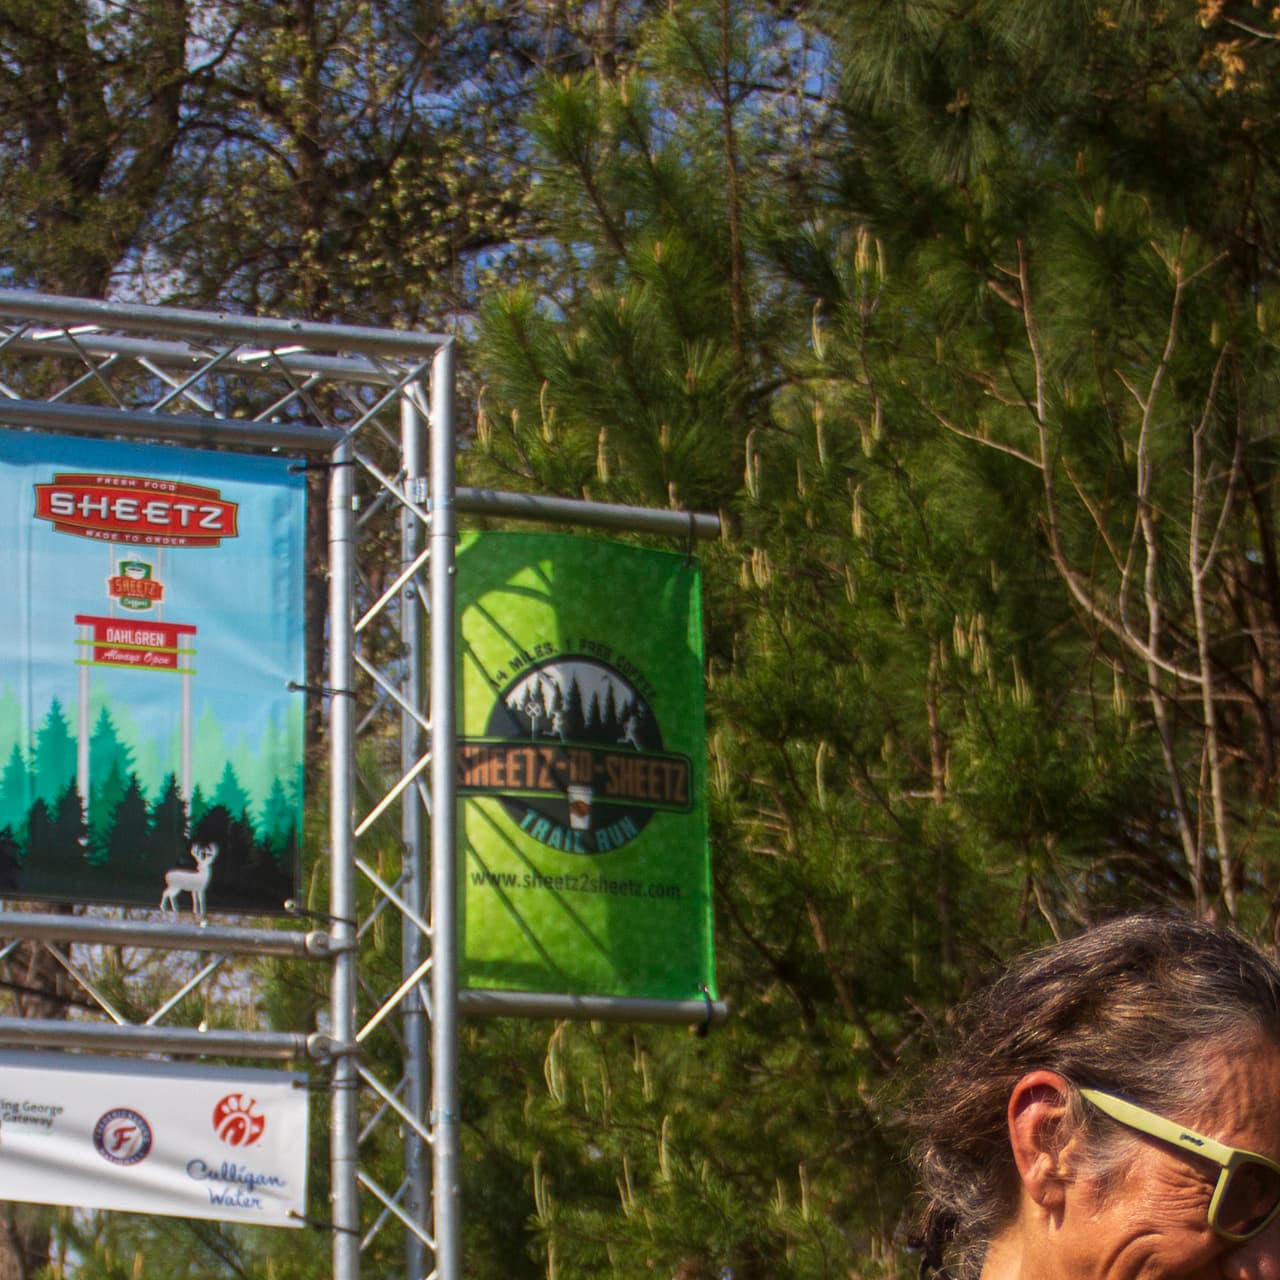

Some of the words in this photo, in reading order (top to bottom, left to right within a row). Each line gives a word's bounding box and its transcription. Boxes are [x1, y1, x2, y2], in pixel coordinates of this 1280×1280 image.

[96, 477, 136, 487] FRESH
[144, 481, 177, 491] FOOD
[50, 492, 223, 529] SHEETZ
[86, 530, 119, 541] MADE
[124, 534, 139, 542] TO
[145, 535, 186, 545] ORDER
[107, 628, 164, 647] DAHLGREN
[102, 649, 140, 663] Always
[143, 652, 170, 666] Open
[520, 808, 585, 854] TRAIL
[595, 816, 638, 852] RUN
[470, 872, 681, 898] www.sheetz2sheetz.com
[22, 1101, 64, 1117] George
[2, 1112, 53, 1128] Gateway
[186, 1158, 285, 1193] Culligan
[208, 1186, 263, 1210] Water
